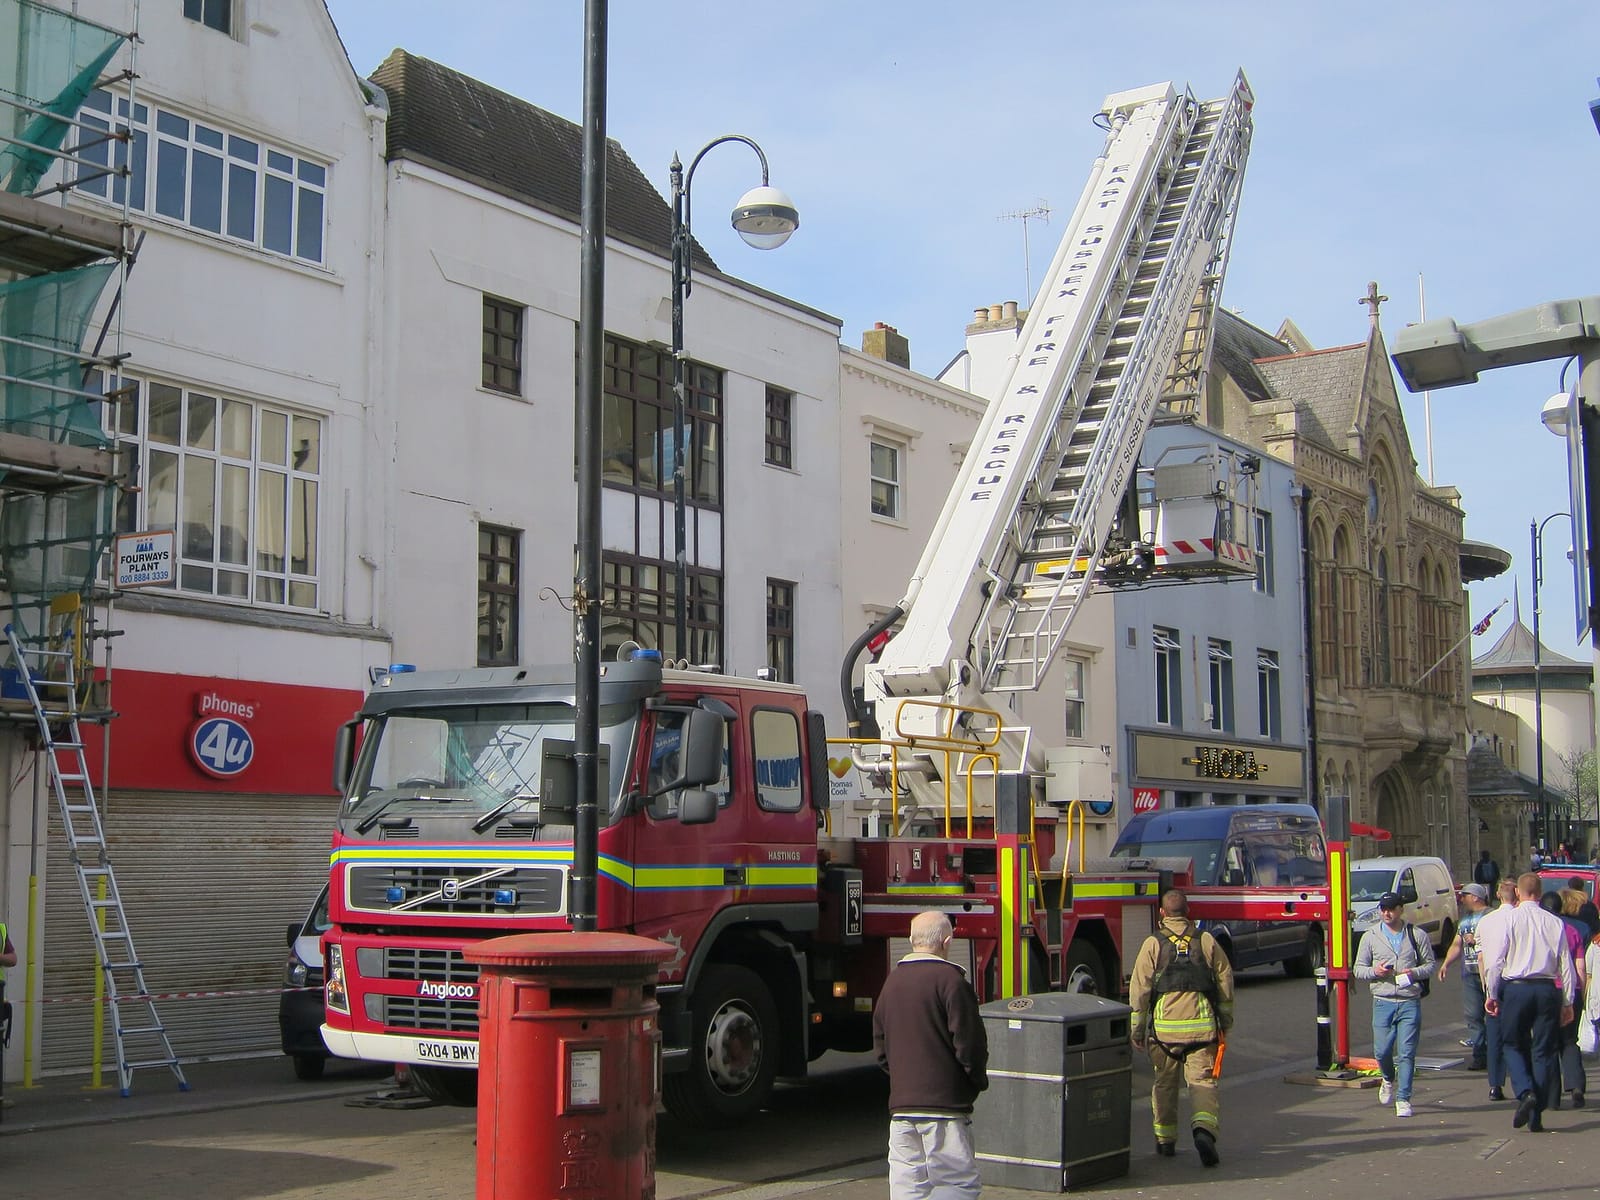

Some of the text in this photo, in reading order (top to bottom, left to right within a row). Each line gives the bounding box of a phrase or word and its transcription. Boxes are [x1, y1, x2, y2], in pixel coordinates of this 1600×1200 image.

[970, 164, 1131, 501] EAST SUSSEX FIRE & RESCUE
[1110, 272, 1197, 498] EAST SUSSEX FIRE AND RESCUE SERVICE
[120, 551, 169, 564] FOURWAYS
[129, 562, 160, 573] PLANT
[120, 575, 132, 584] 020
[202, 692, 254, 718] phones
[200, 722, 249, 768] 4u
[1199, 747, 1259, 780] MODA
[830, 780, 853, 788] homas
[831, 788, 848, 796] Cook
[1135, 791, 1157, 810] illy
[768, 850, 801, 861] HASTINGS
[848, 888, 860, 898] 999
[850, 923, 859, 932] 112
[420, 980, 474, 1000] Angloco
[418, 1042, 476, 1060] GX04 BMY
